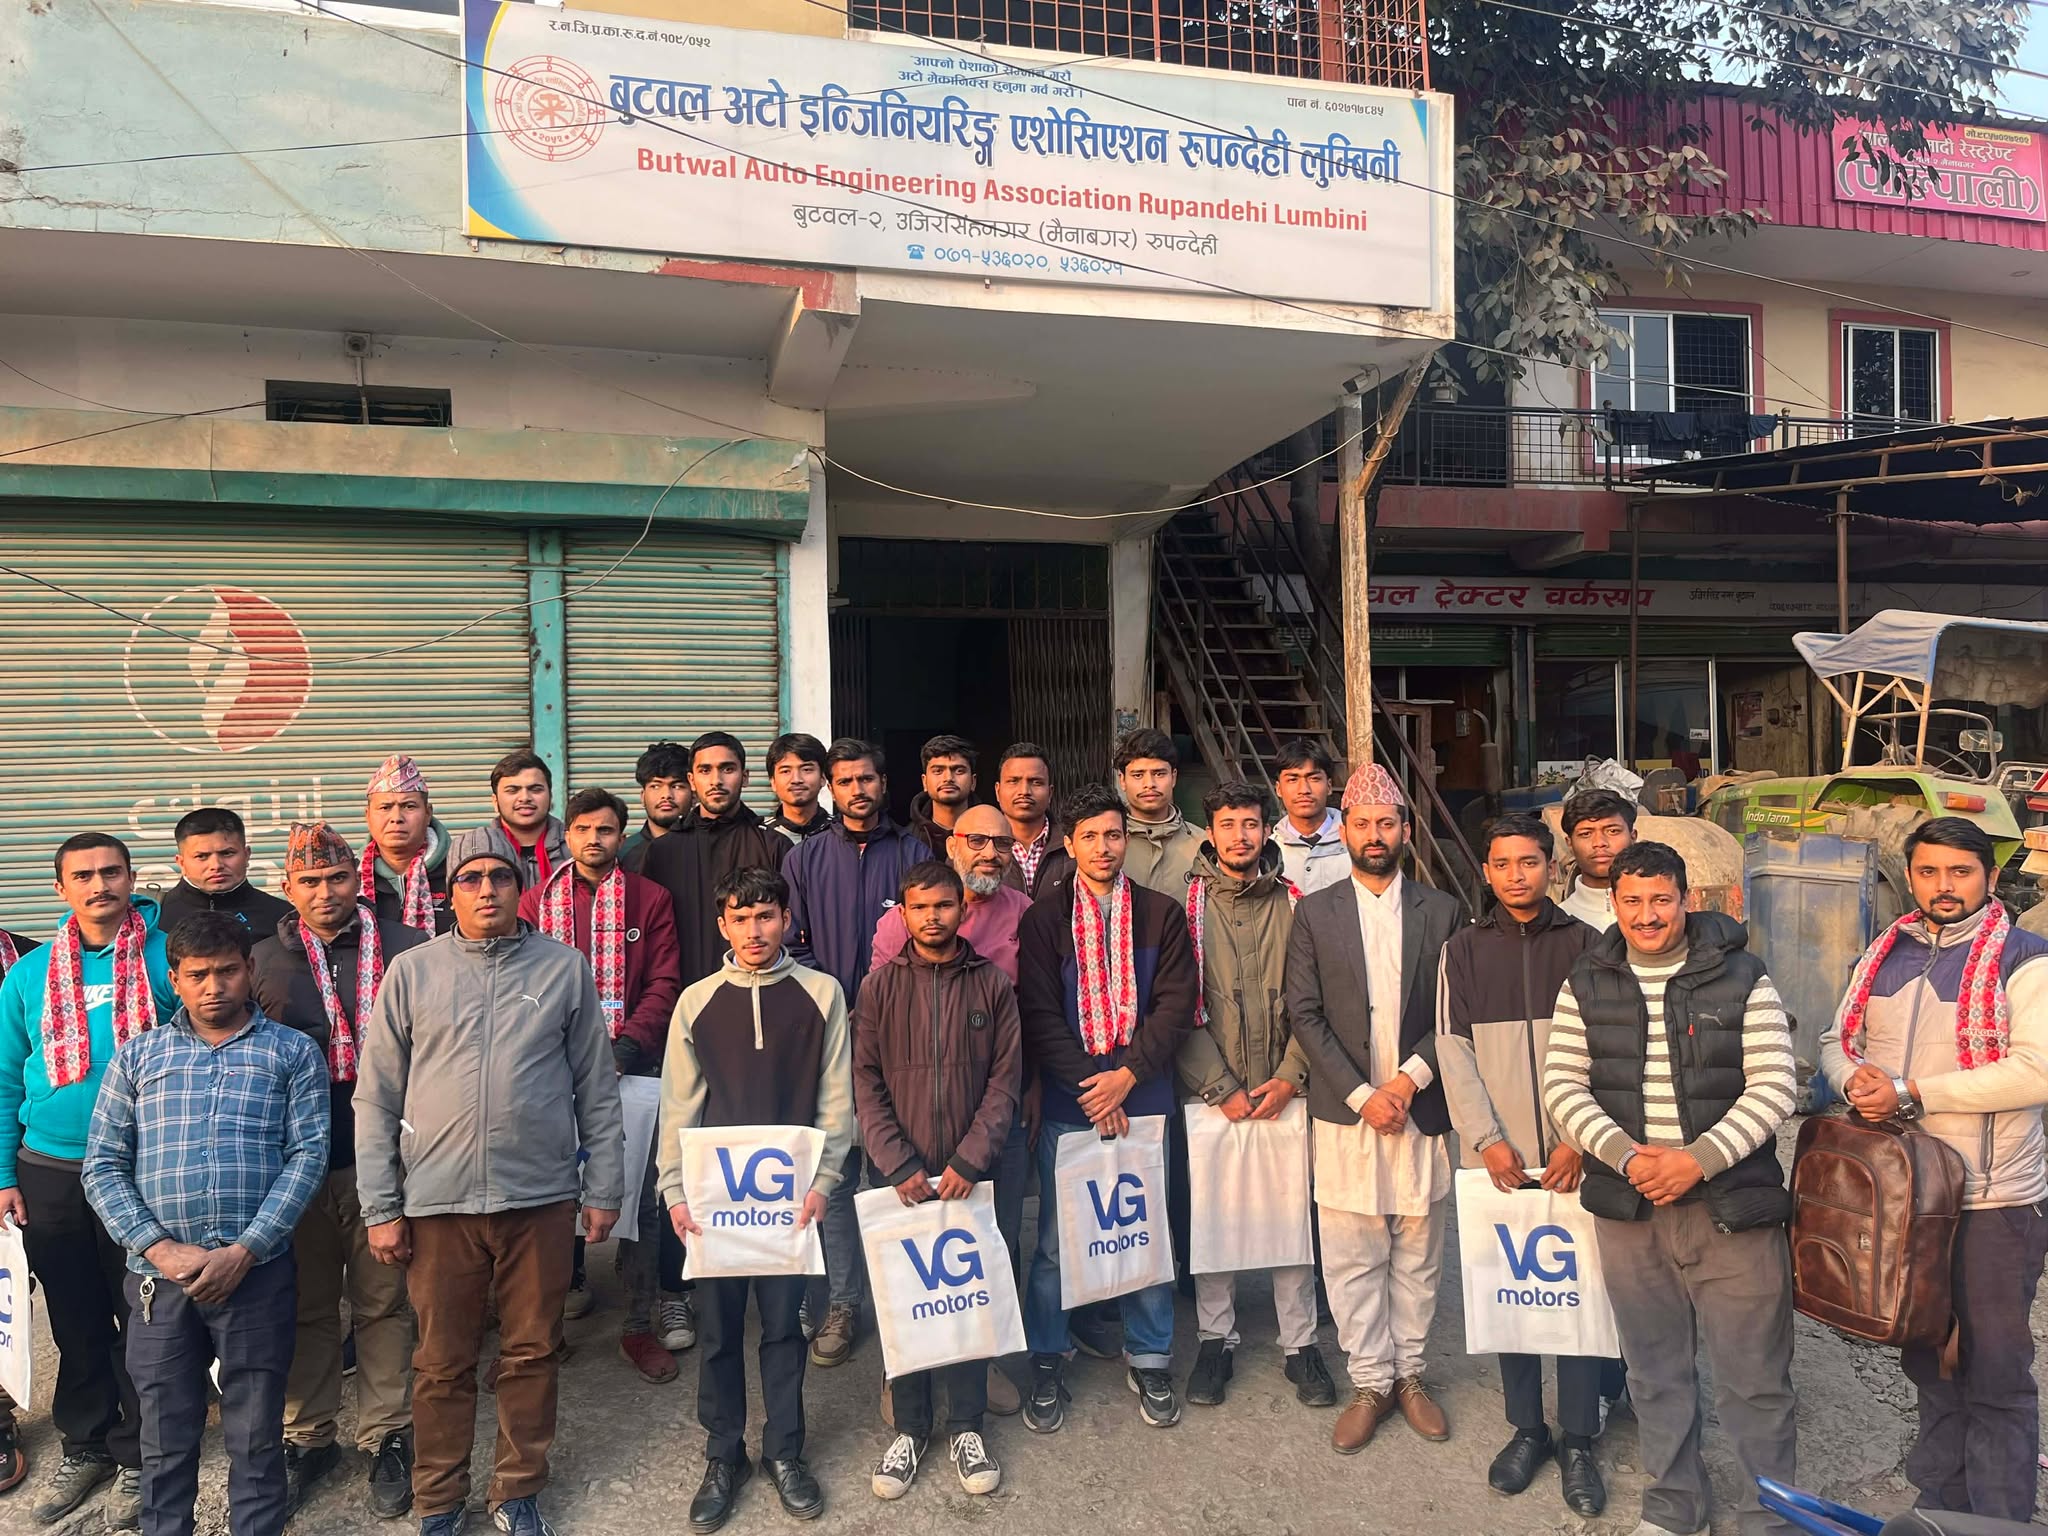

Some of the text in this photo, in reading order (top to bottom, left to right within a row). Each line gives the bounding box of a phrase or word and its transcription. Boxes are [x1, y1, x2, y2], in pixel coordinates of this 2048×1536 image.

[1287, 97, 1307, 109] पान
[608, 72, 712, 126] बुटवल
[723, 78, 792, 129] अटो
[1009, 105, 1169, 166] एशोसिएशन
[1300, 137, 1402, 190] लुम्बिनी
[637, 147, 1368, 232] Butwal Auto Engineering Association Rupandehi Lumbini
[792, 203, 887, 233] बुटवल-२,
[1038, 219, 1138, 252] (मैनाबगर)
[1368, 585, 1421, 606] वल
[1434, 579, 1530, 609] ट्रेक्टर
[1745, 810, 1765, 823] Indo
[715, 1147, 796, 1202] VG
[711, 1206, 795, 1227] motors
[1086, 1172, 1148, 1231] VG
[900, 1228, 985, 1291] VG
[1088, 1230, 1150, 1258] motors
[1494, 1223, 1578, 1283] VG
[911, 1289, 990, 1321] motors
[1496, 1286, 1581, 1307] motors
